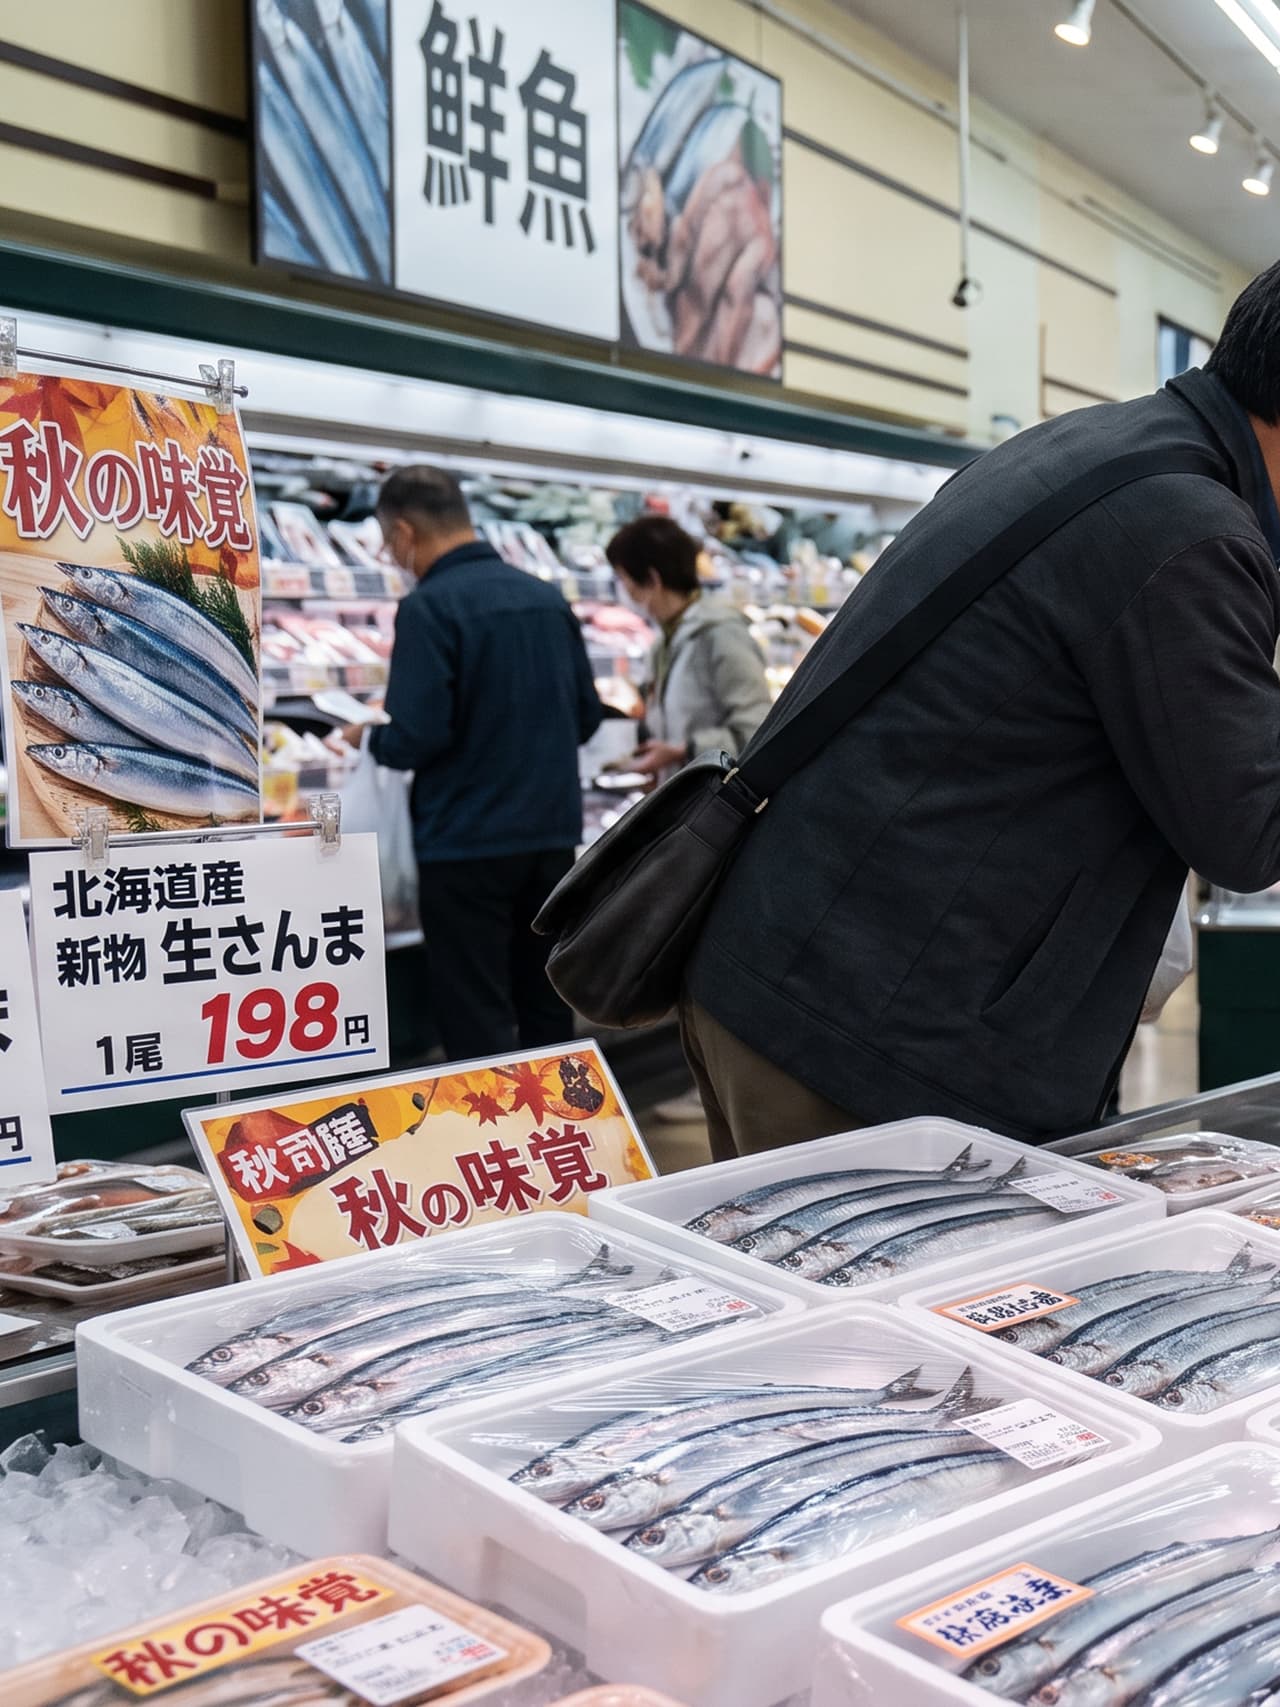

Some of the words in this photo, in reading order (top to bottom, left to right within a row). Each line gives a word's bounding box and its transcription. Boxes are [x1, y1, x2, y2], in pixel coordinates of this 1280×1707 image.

[419, 0, 596, 255] 鮮魚
[0, 421, 250, 547] 秋の味覚
[53, 860, 246, 920] 北海道産
[57, 932, 147, 988] 新物
[160, 904, 366, 985] 生さんま
[96, 1031, 164, 1076] 1尾
[200, 981, 370, 1065] 198円
[330, 1124, 608, 1251] 秋の味覚
[103, 1572, 380, 1686] 秋の味覚
